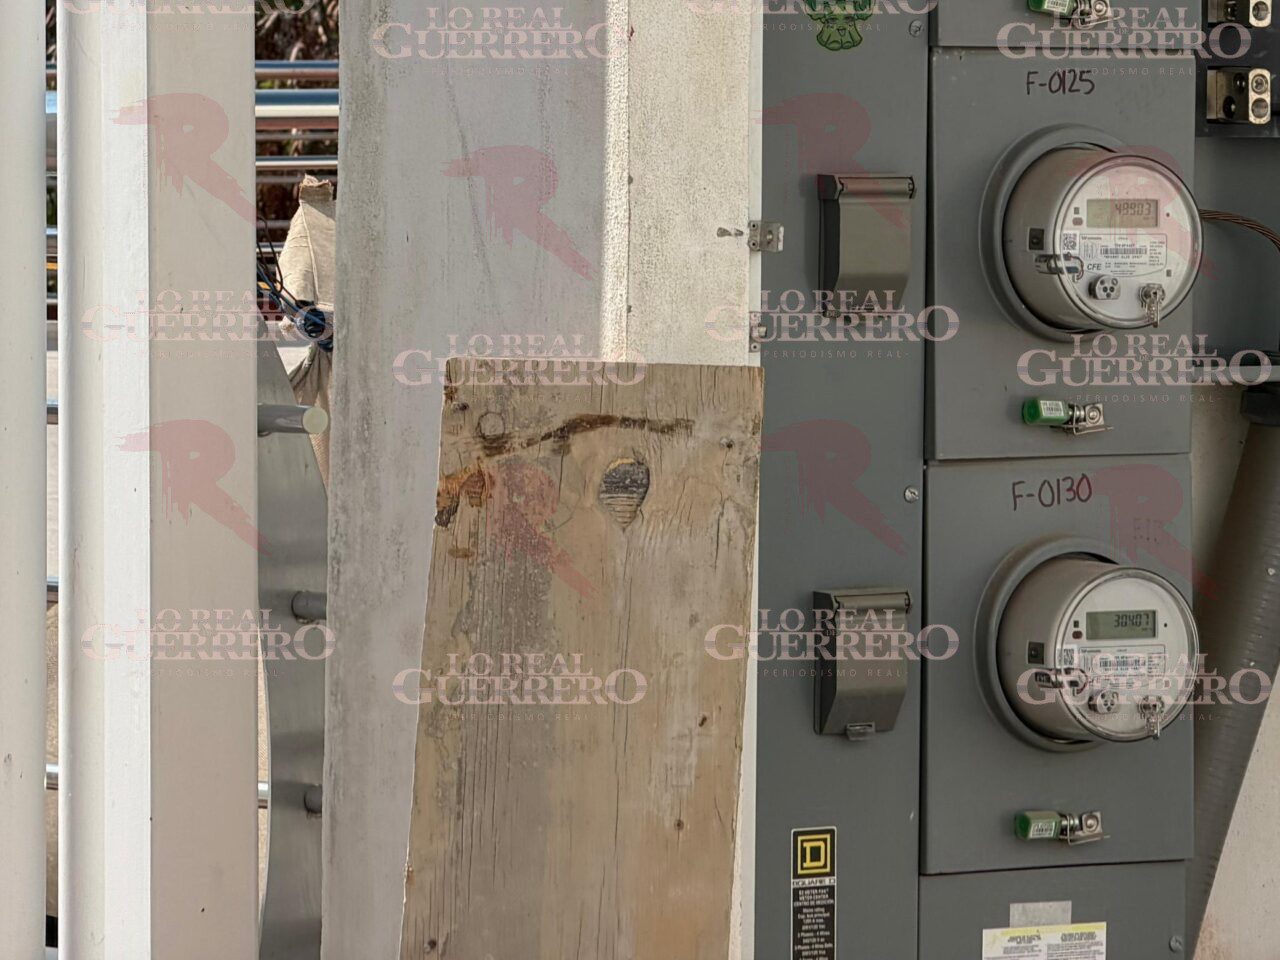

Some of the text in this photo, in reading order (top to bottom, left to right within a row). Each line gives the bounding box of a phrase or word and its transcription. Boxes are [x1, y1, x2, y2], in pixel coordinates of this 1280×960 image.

[1025, 68, 1096, 96] F-0125
[1087, 263, 1102, 271] CFE
[1011, 472, 1093, 511] F-0130
[1114, 614, 1150, 628] 30407
[802, 840, 826, 868] D
